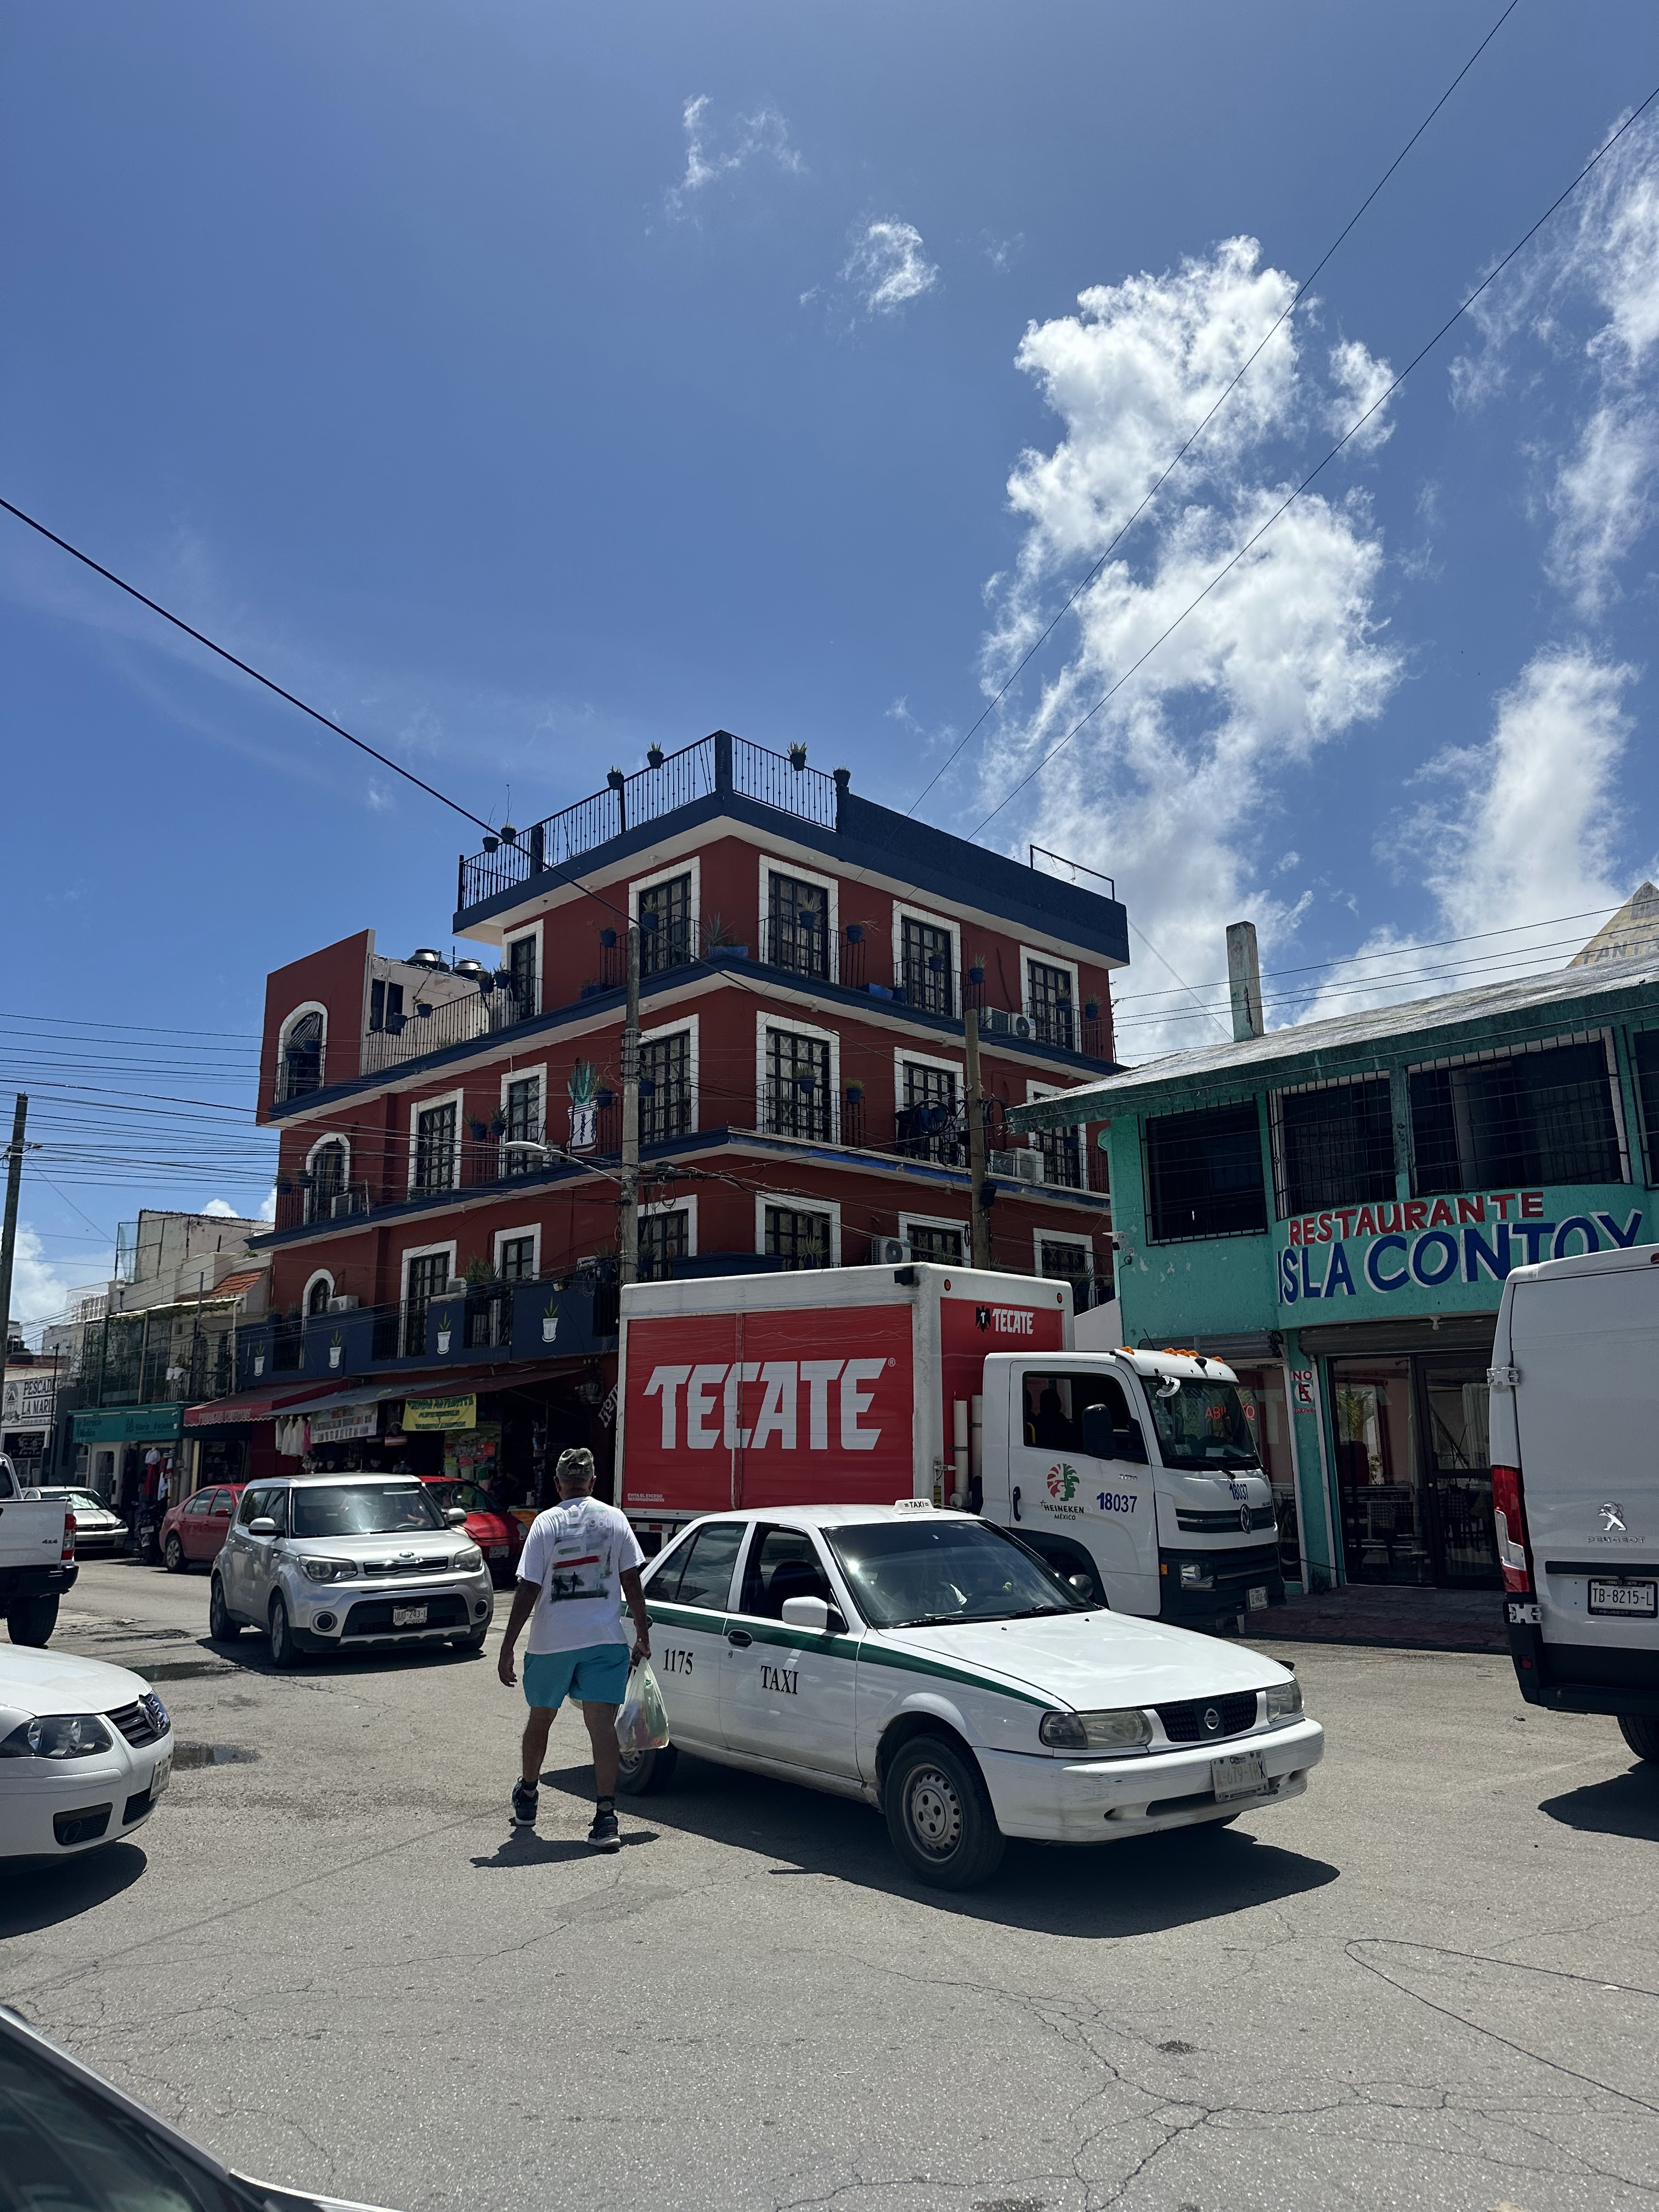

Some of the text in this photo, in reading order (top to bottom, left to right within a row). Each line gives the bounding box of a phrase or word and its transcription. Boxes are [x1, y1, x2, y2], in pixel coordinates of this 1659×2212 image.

[1289, 1192, 1543, 1246] RESTAURANTE
[1278, 1209, 1643, 1305] ISLA CONTOY
[992, 1308, 1035, 1334] TECATE
[1293, 1370, 1313, 1381] NO
[1096, 1492, 1137, 1513] 18037
[1229, 1483, 1249, 1500] 18037
[1043, 1504, 1085, 1514] HEINEKEN
[1592, 1588, 1653, 1606] TB-8215-L
[663, 1647, 693, 1675] 1175
[760, 1665, 799, 1695] TAXI
